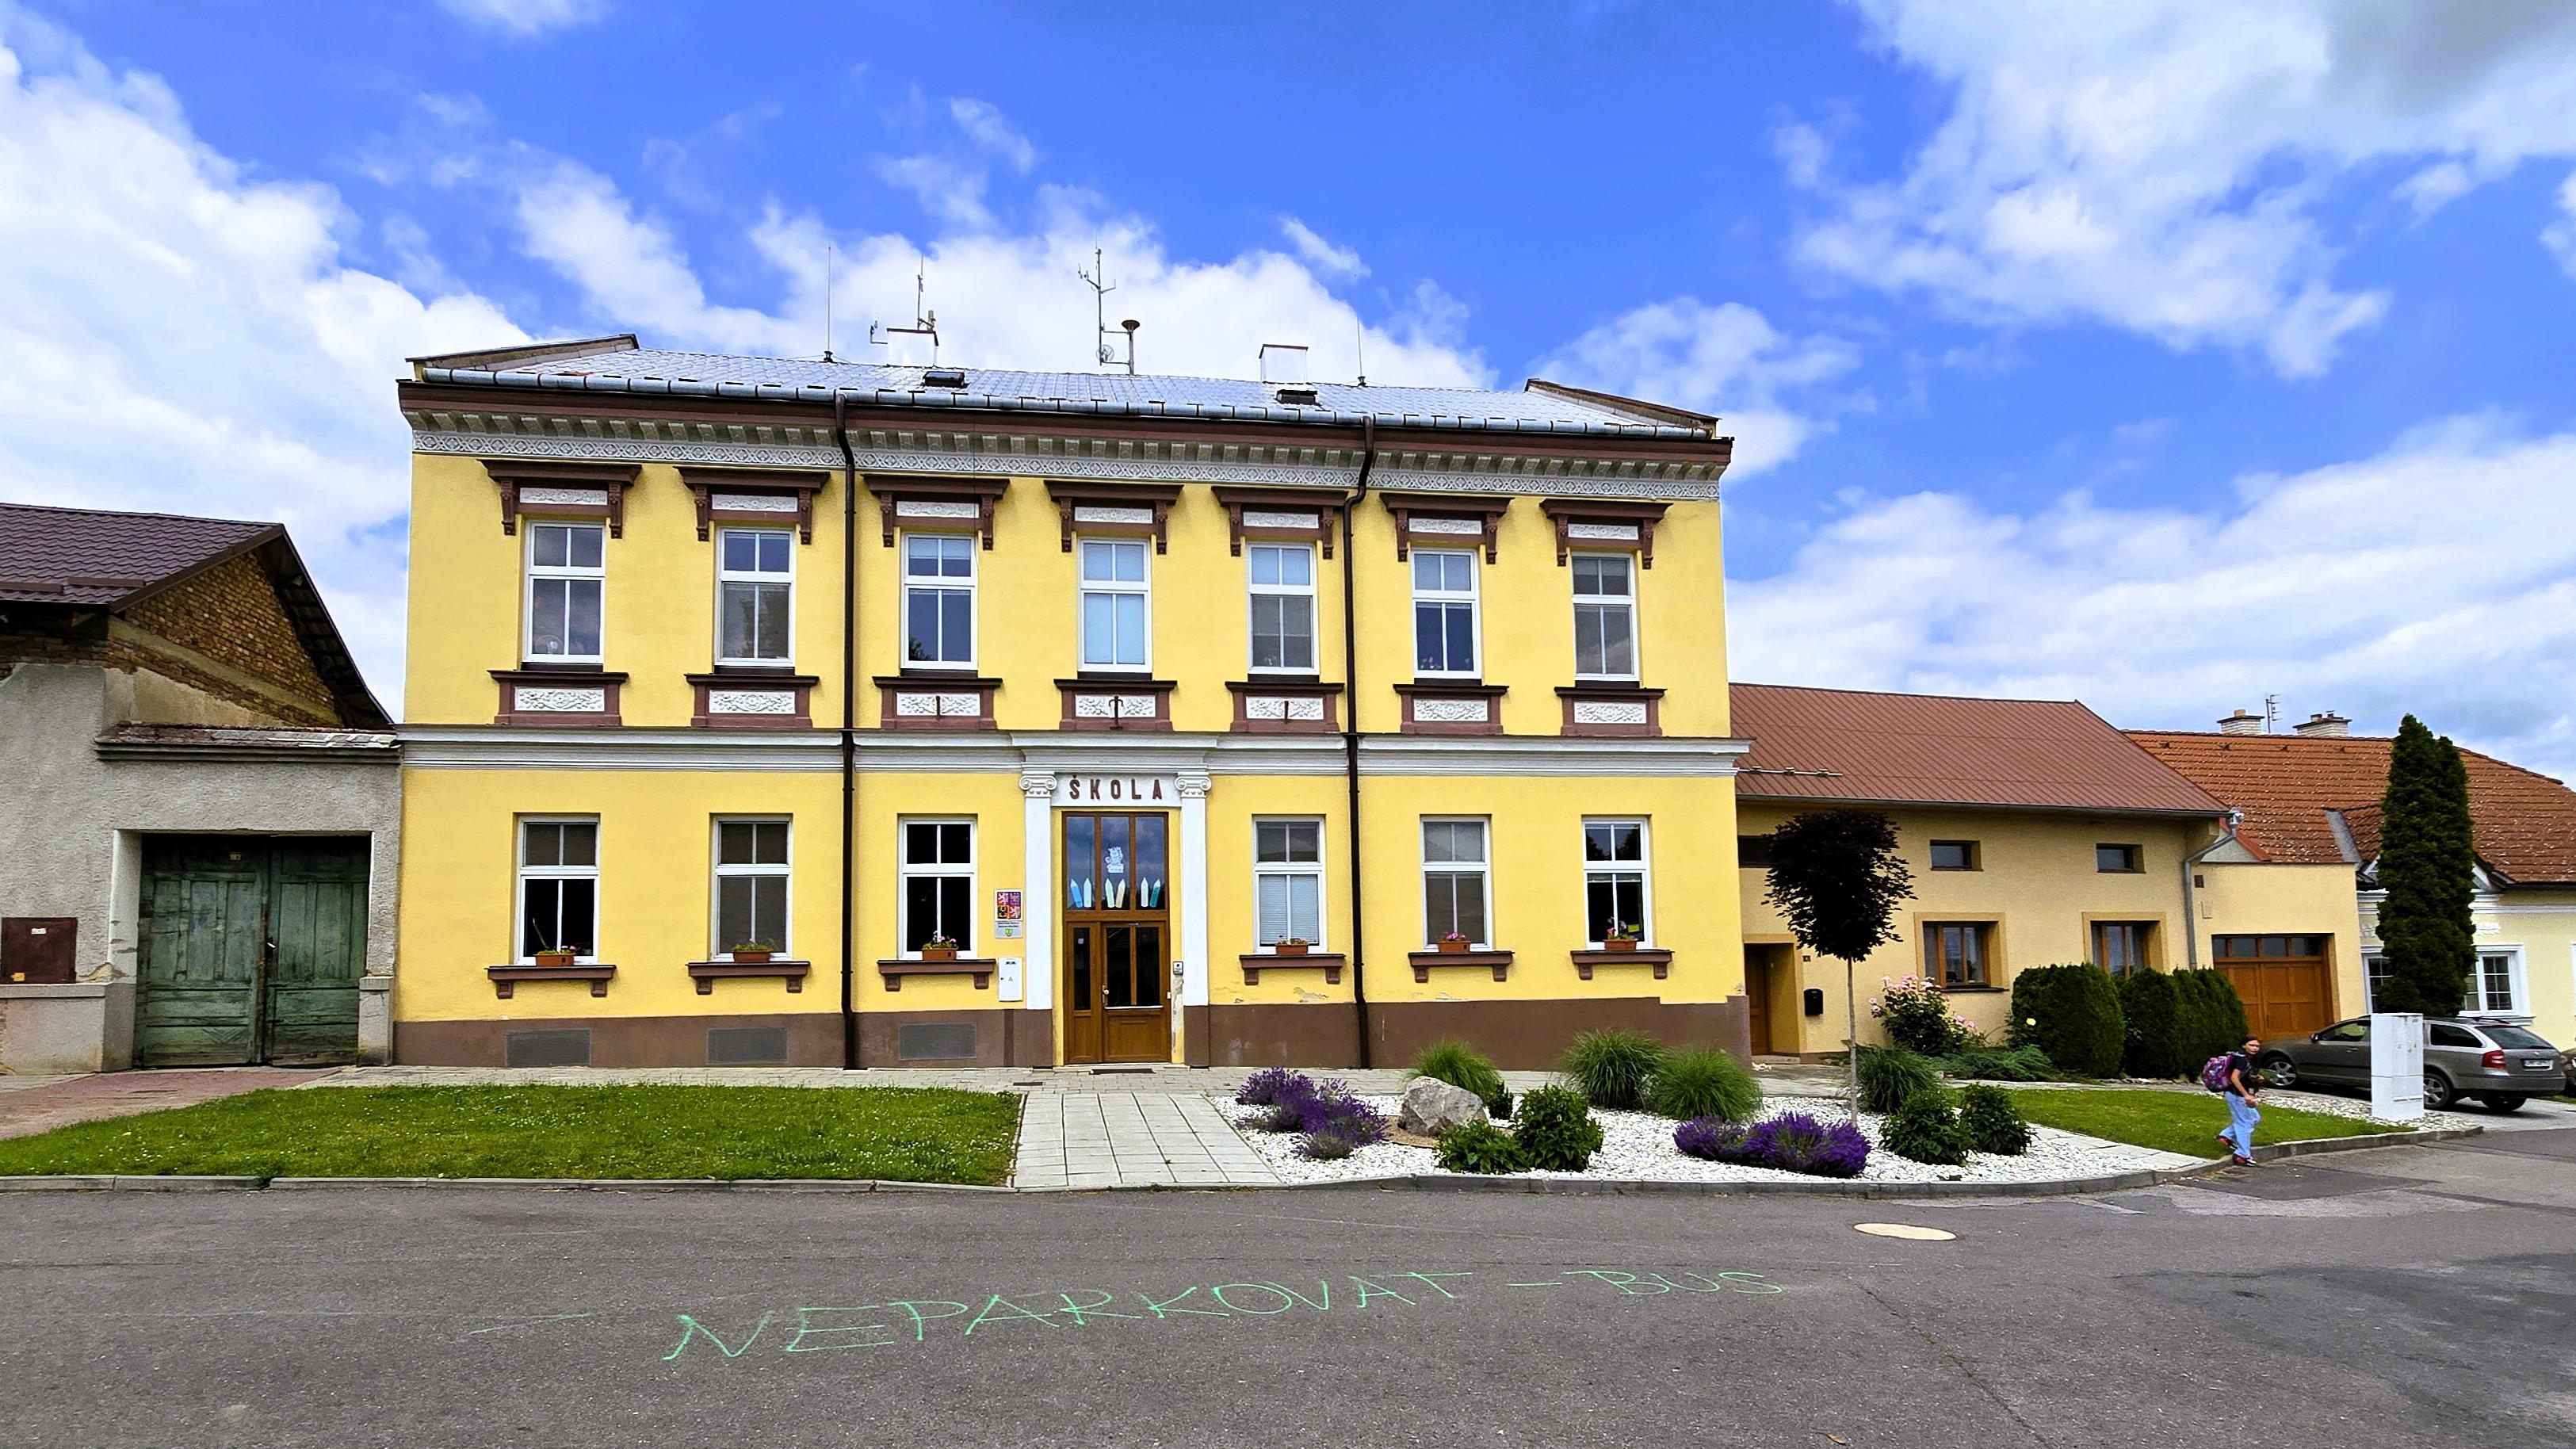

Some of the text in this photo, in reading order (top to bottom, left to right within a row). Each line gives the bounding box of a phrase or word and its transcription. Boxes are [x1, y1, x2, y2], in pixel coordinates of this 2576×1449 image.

[1069, 774, 1163, 800] ŠKOLA
[662, 1271, 1473, 1360] NEPARKOVAT
[1561, 1270, 1783, 1295] BUS
